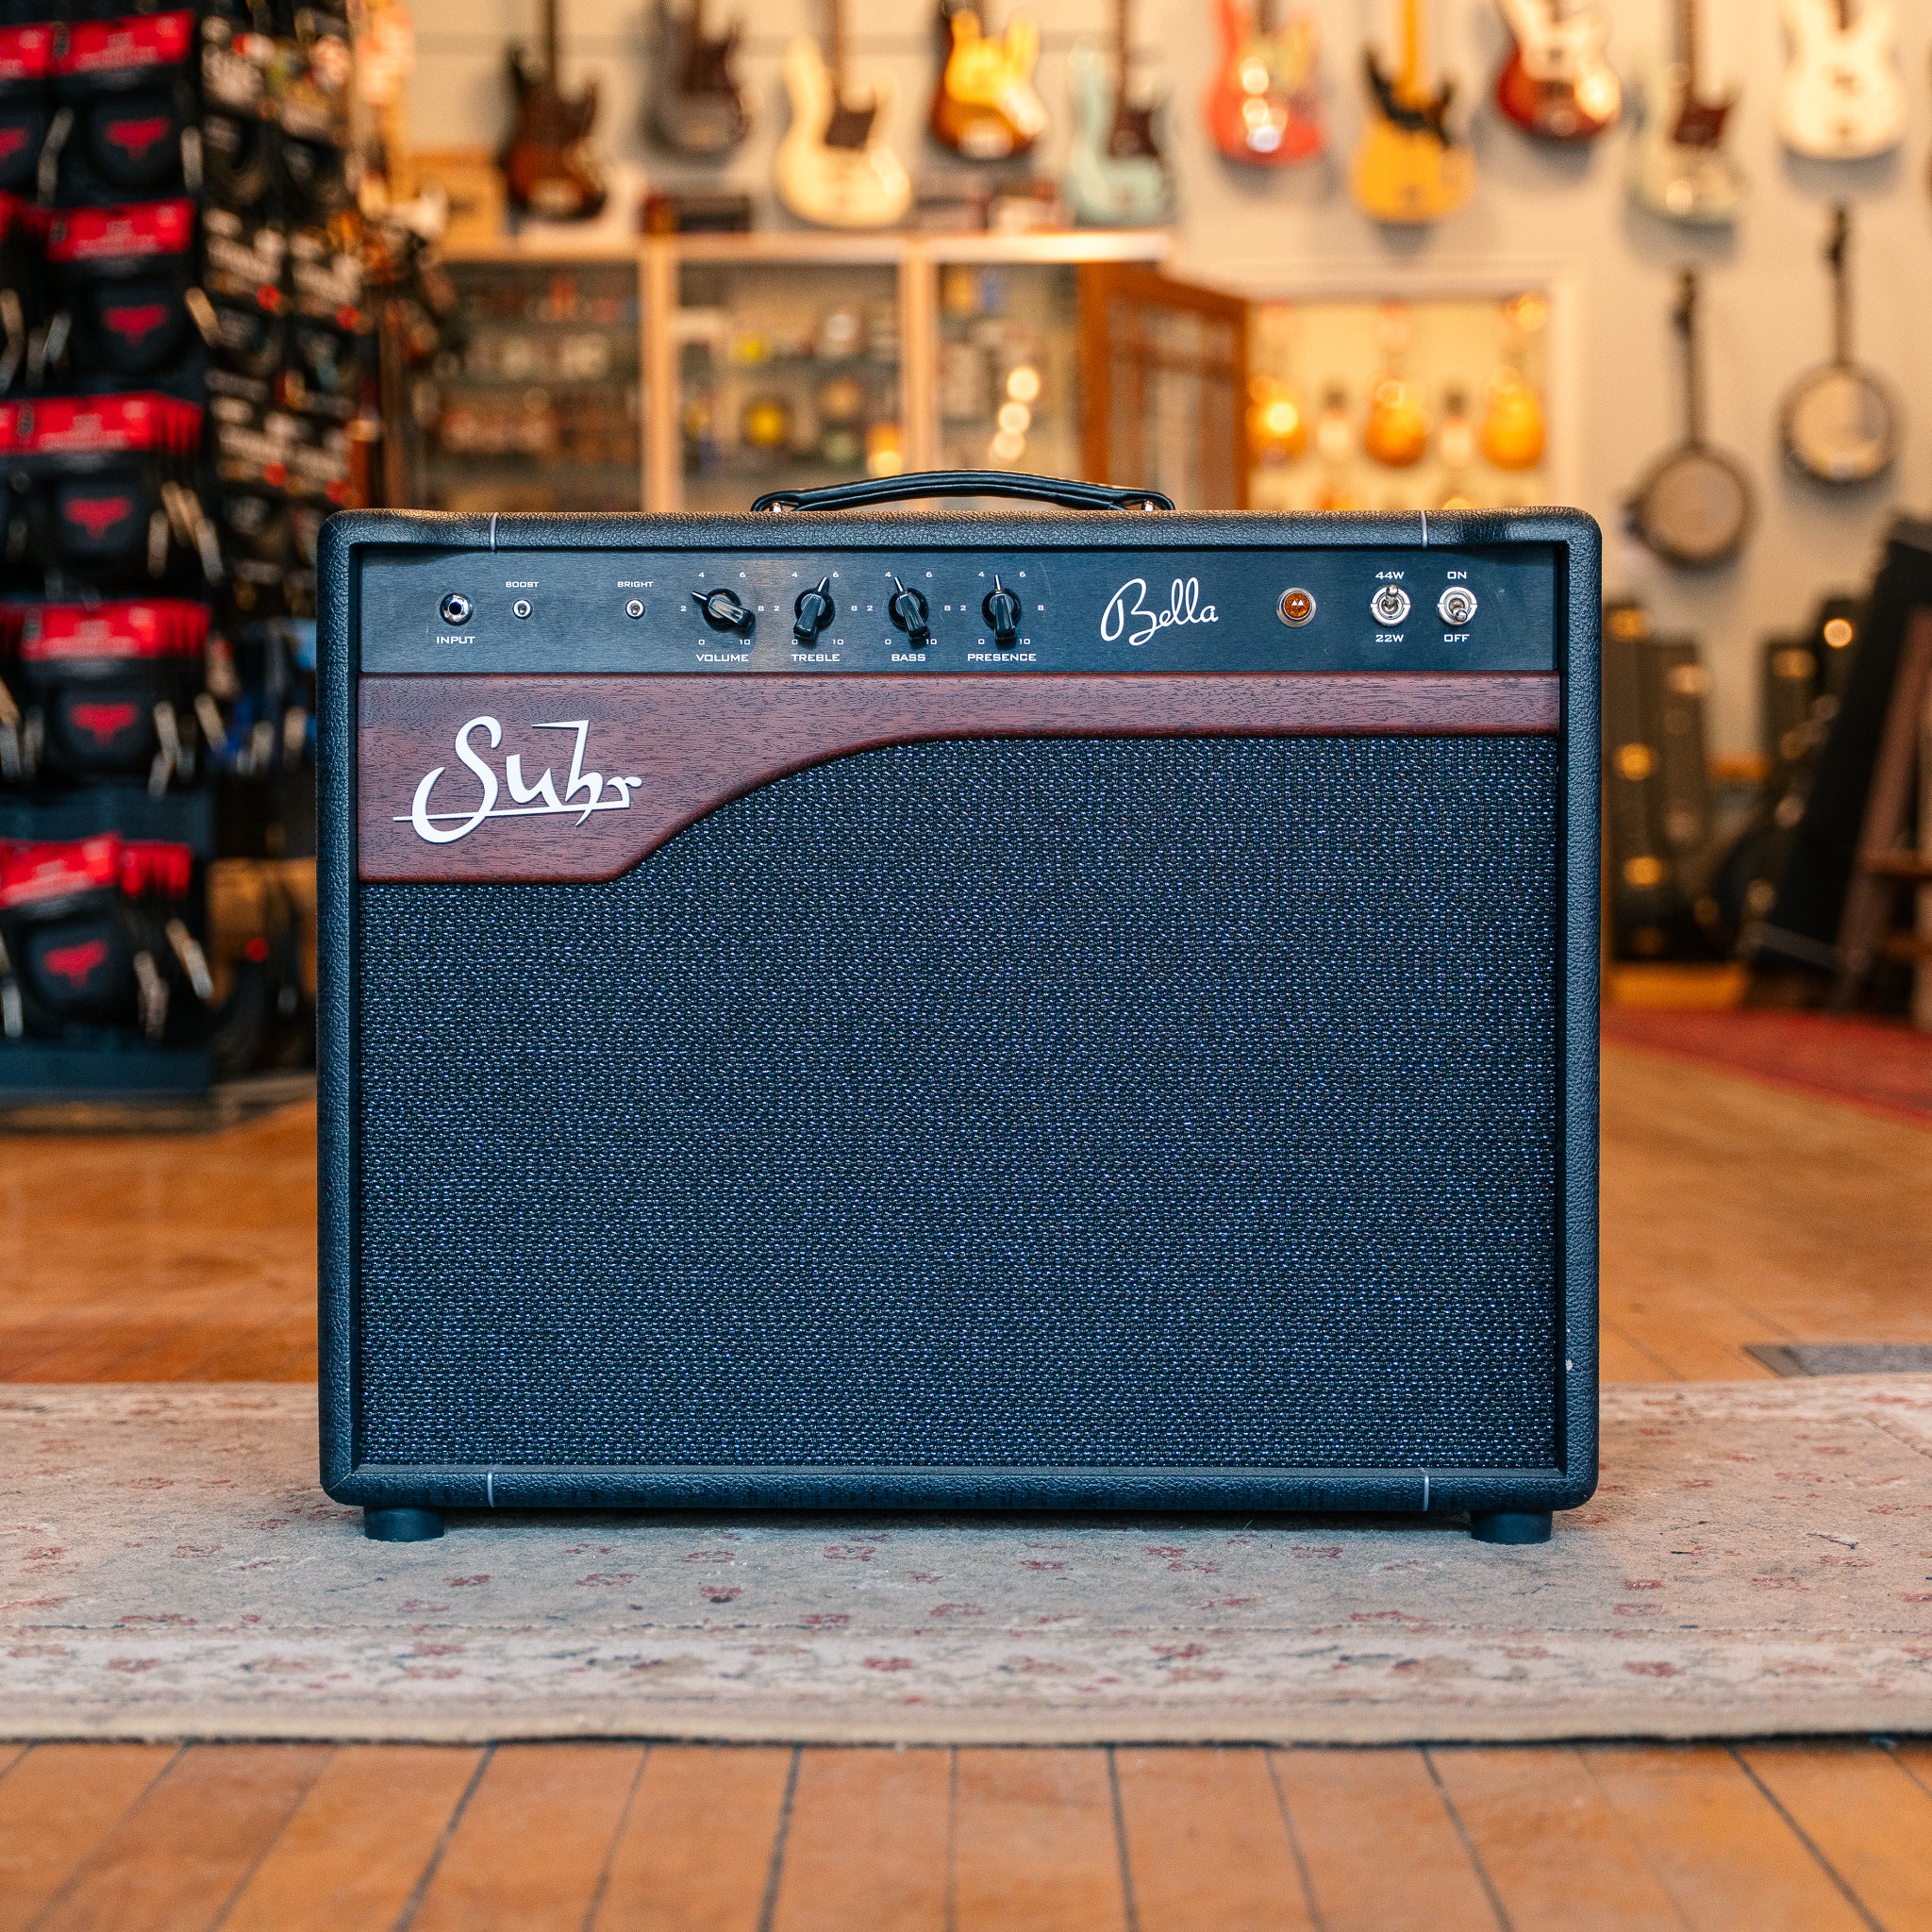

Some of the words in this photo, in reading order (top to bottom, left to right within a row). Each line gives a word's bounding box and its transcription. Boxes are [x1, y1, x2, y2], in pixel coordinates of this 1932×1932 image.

[1374, 571, 1405, 580] 44W
[1446, 571, 1467, 580] ON
[1100, 576, 1219, 646] Bella
[436, 636, 476, 644] INPUT
[1374, 634, 1405, 642] 22W
[1443, 633, 1471, 642] OFF
[695, 654, 749, 662] VOLUME
[790, 653, 841, 662] TREBLE
[891, 653, 926, 662] BASS
[967, 653, 1037, 662] PRESENCE
[392, 715, 643, 843] Suhr
